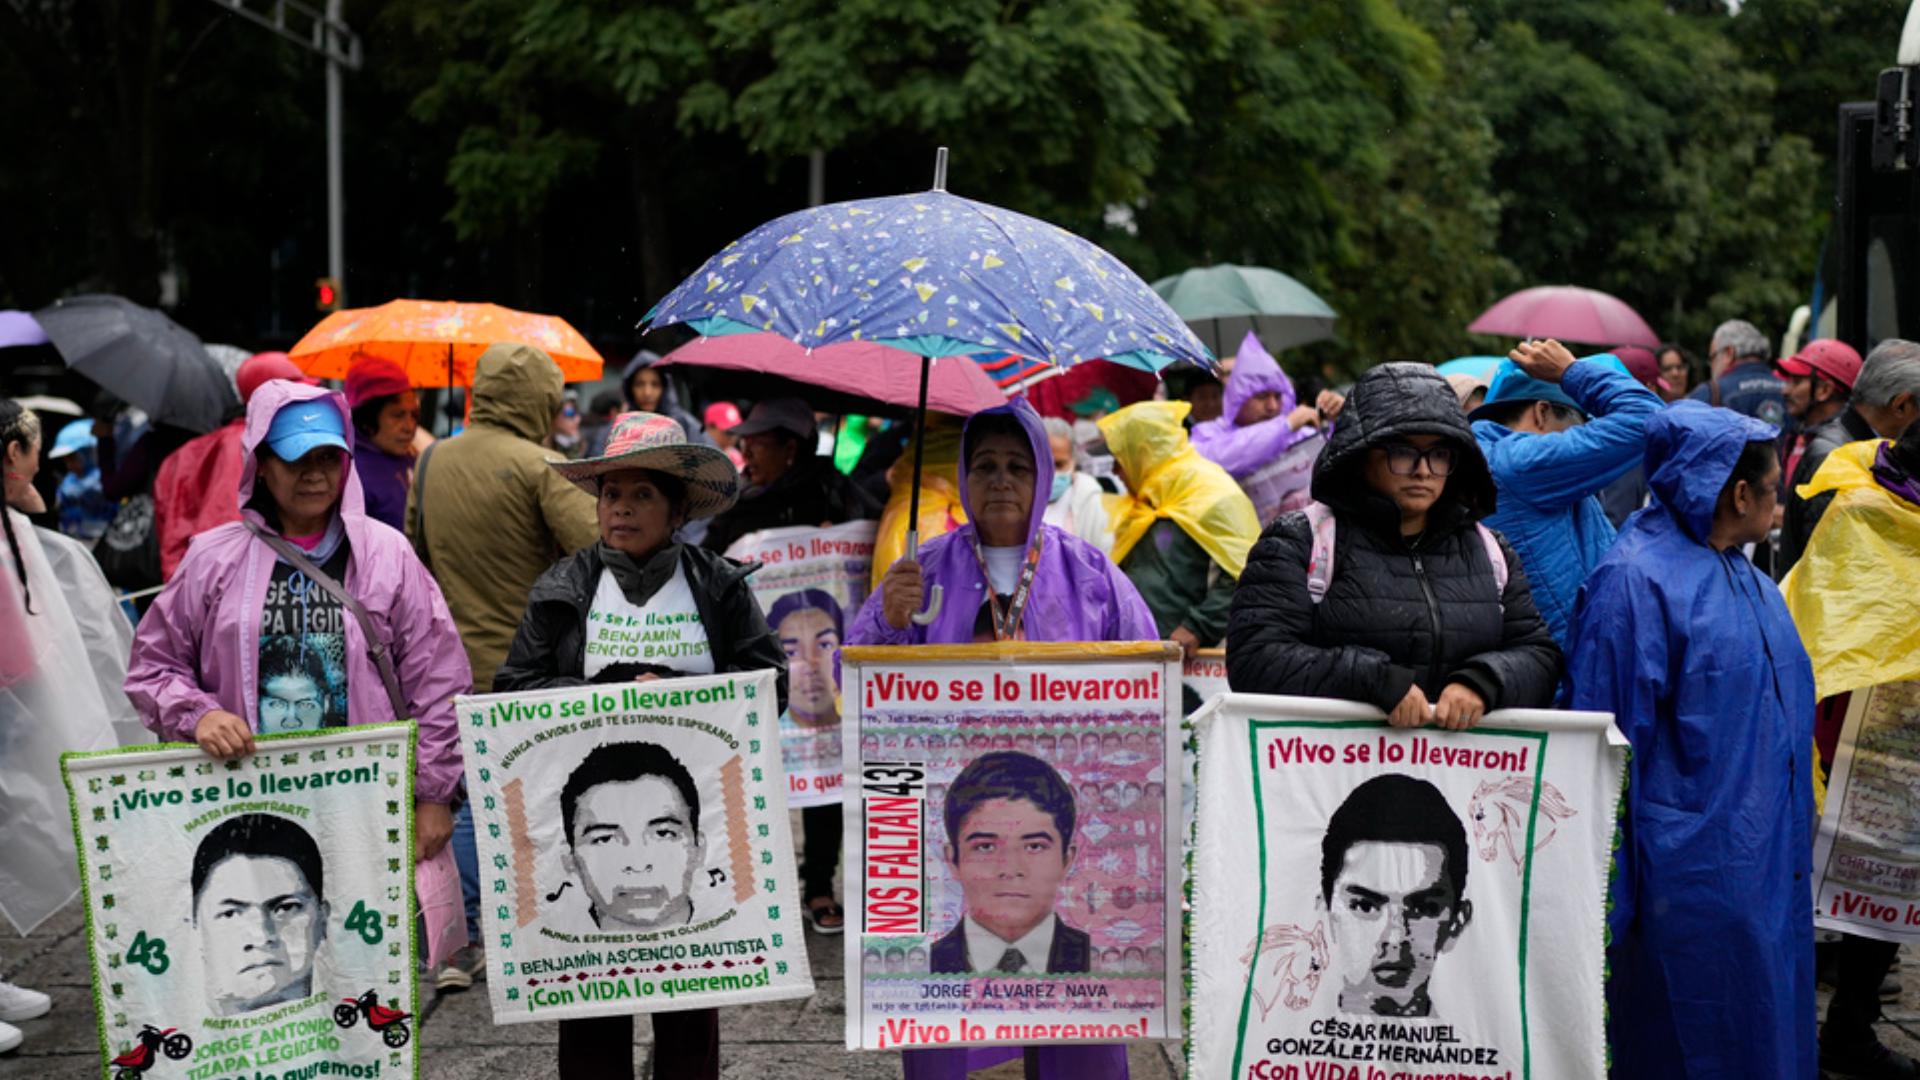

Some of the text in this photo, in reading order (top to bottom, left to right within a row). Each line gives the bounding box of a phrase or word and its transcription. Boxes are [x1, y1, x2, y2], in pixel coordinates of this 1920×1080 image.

[760, 549, 782, 565] se
[788, 543, 805, 560] lo
[598, 627, 681, 643] BENJAMÍN
[490, 680, 735, 727] ¡Vivo se lo llevaron!
[865, 672, 1159, 707] ¡Vivo se lo llevaron!
[501, 714, 740, 769] NUNCA OLVIDES QUE TE ESTAMOS ESPERANDO
[1268, 736, 1529, 771] ¡Vivo se lo llevaron!
[113, 762, 380, 819] ¡Vivo se lo llevaron!
[790, 773, 806, 793] lo
[864, 761, 924, 933] NOS FALTAN 43!
[345, 900, 383, 945] 43
[1830, 891, 1899, 923] ¡Vivo
[540, 926, 580, 943] NUNCA
[126, 931, 169, 975] 43
[520, 937, 768, 975] BENJAMÍN ASCENCIO BAUTISTA
[527, 967, 770, 1011] ¡Con VIDA lo queremos!
[920, 980, 1108, 999] JORGE ÁLVAREZ NAVA
[193, 1018, 334, 1063] JORGE ANTONIO
[879, 1018, 1148, 1048] ¡Vivo lo queremos!
[1310, 1019, 1460, 1043] CÉSAR MANUEL
[187, 1055, 251, 1080] TIZAPA
[1267, 1038, 1498, 1065] GONZÁLEZ HERNÁNDEZ
